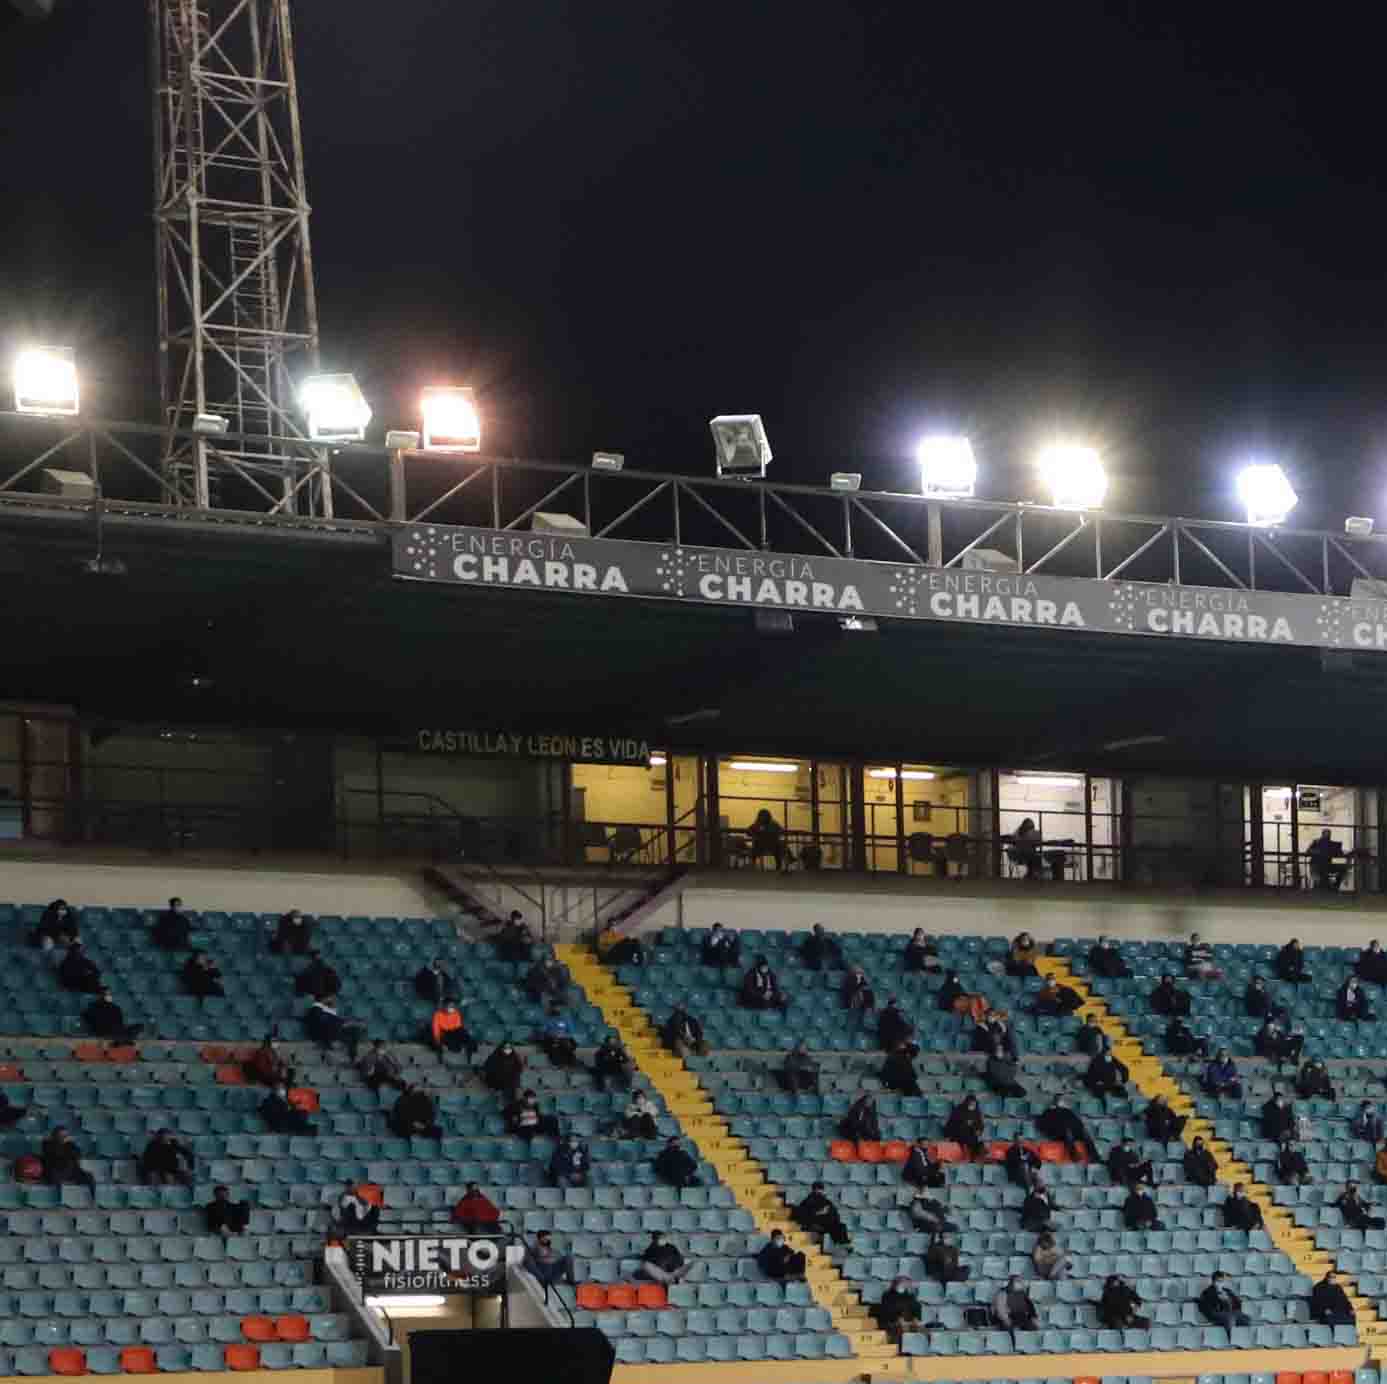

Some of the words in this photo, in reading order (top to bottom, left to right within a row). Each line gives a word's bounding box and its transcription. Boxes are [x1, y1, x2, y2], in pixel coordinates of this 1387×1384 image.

[451, 533, 575, 560] ENERGÍA
[453, 555, 628, 593] CHARRA
[698, 554, 815, 579] ENERGÍA
[700, 574, 864, 609] CHARRA
[929, 573, 1039, 595] ENERGÍA
[930, 593, 1085, 626] CHARRA
[1148, 608, 1294, 640] CHARRA
[417, 729, 510, 753] CASTILLA
[511, 734, 522, 754] Y
[581, 737, 604, 759] ES
[609, 738, 650, 761] VIDA
[373, 1239, 499, 1271] NIETO
